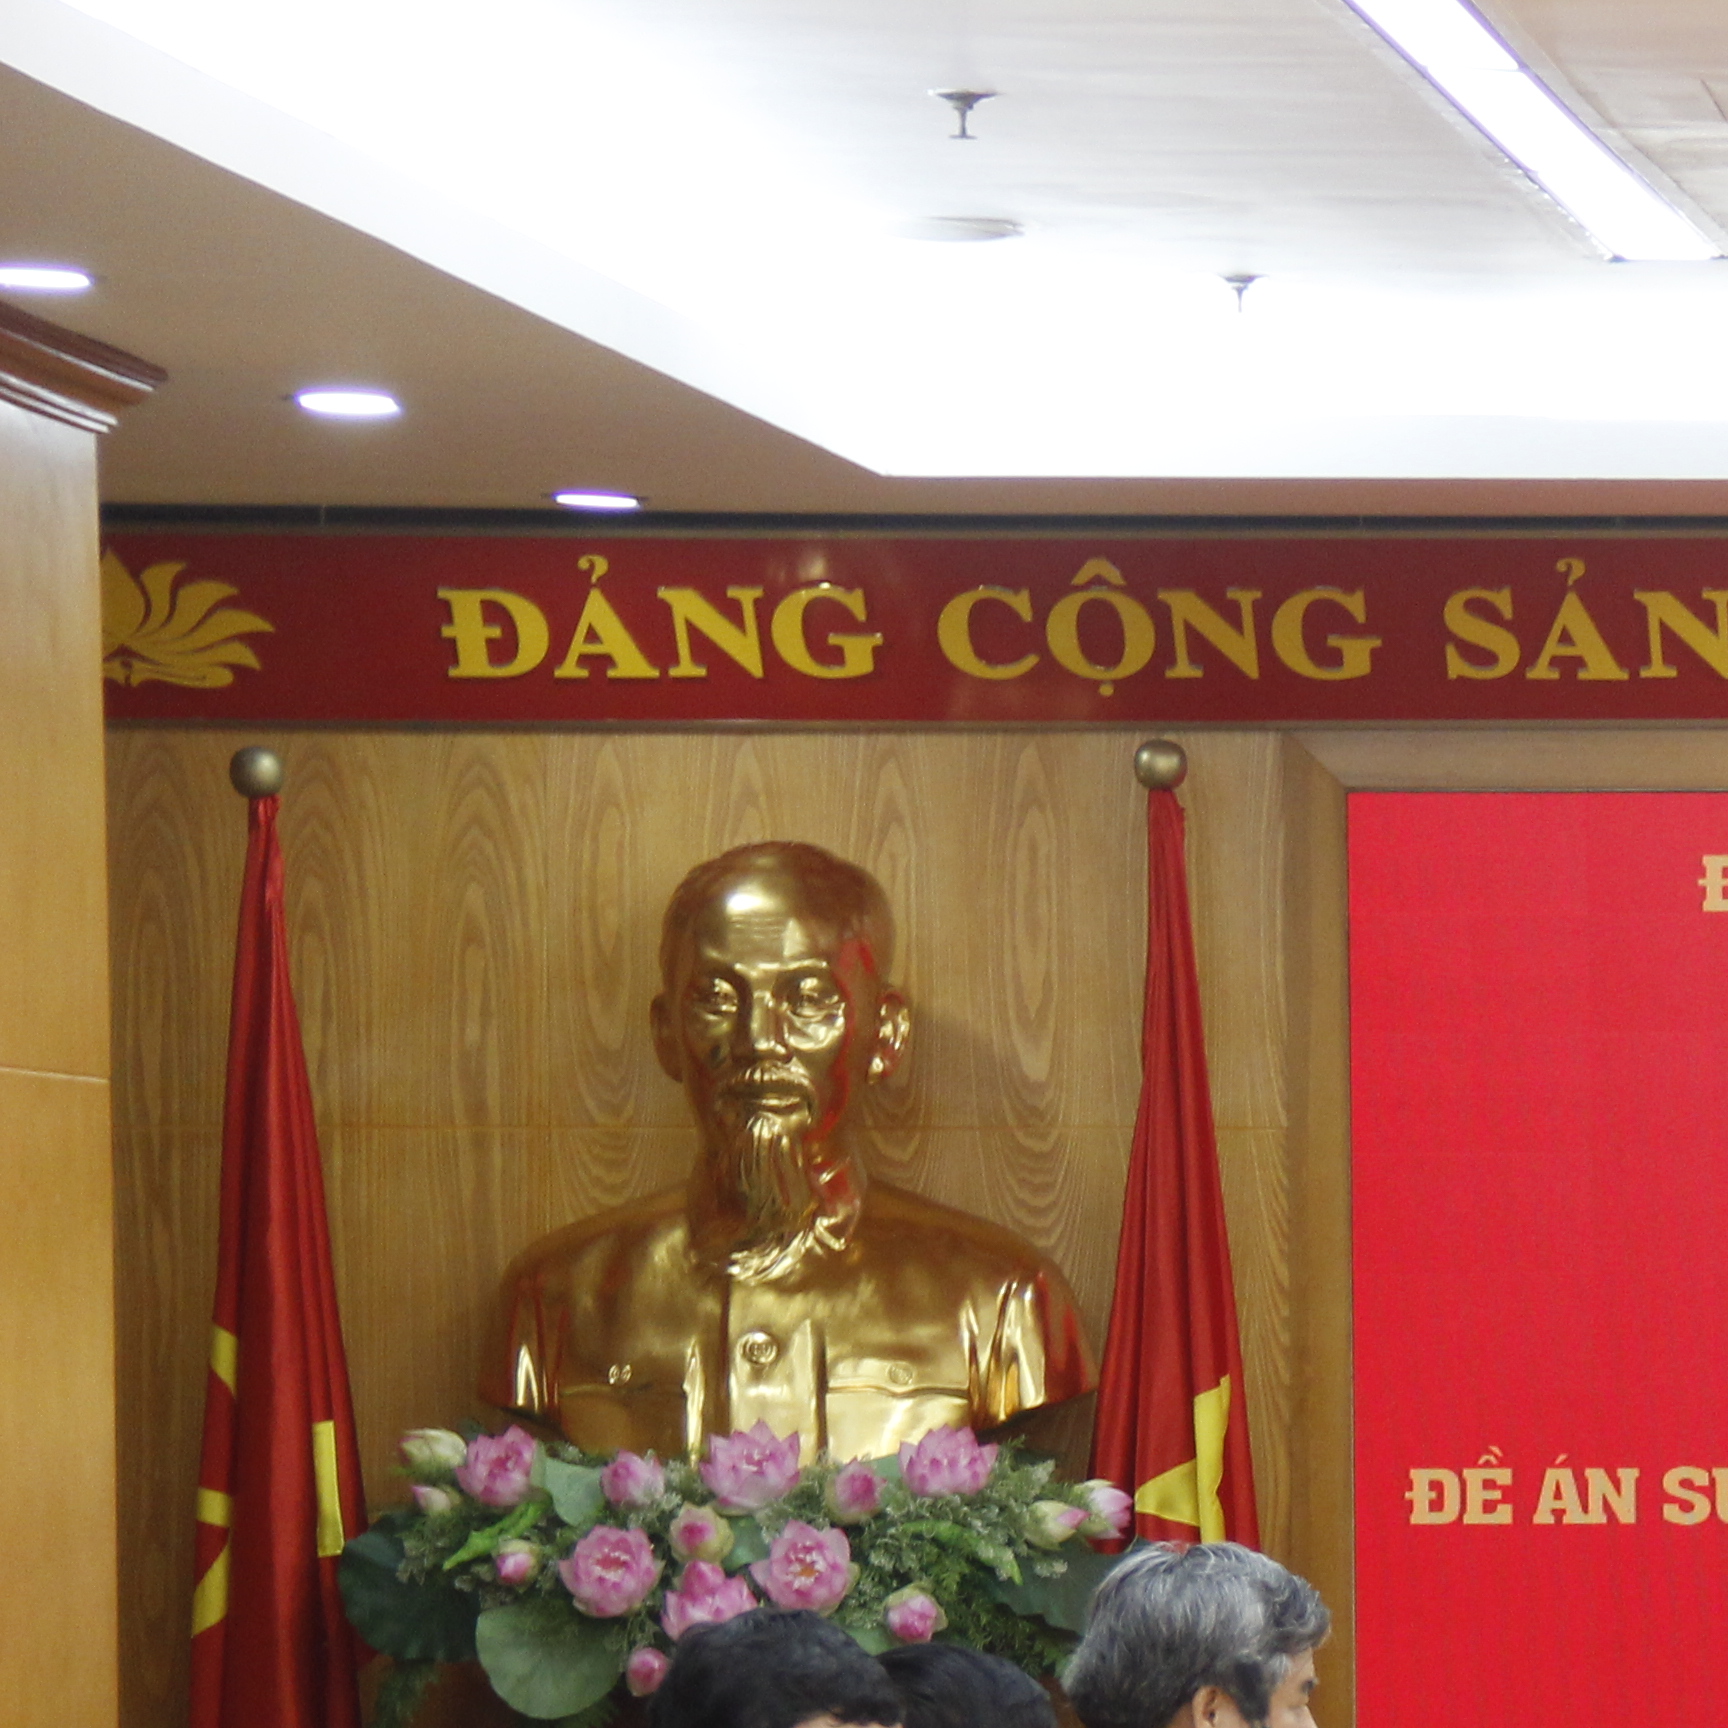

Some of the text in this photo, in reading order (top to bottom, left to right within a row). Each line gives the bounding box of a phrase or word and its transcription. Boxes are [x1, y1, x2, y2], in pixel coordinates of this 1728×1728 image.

[437, 554, 883, 680] ĐẢNG
[937, 557, 1381, 697] CỘNG
[1404, 1446, 1513, 1525] ĐỀ
[1532, 1454, 1640, 1525] ÁN
